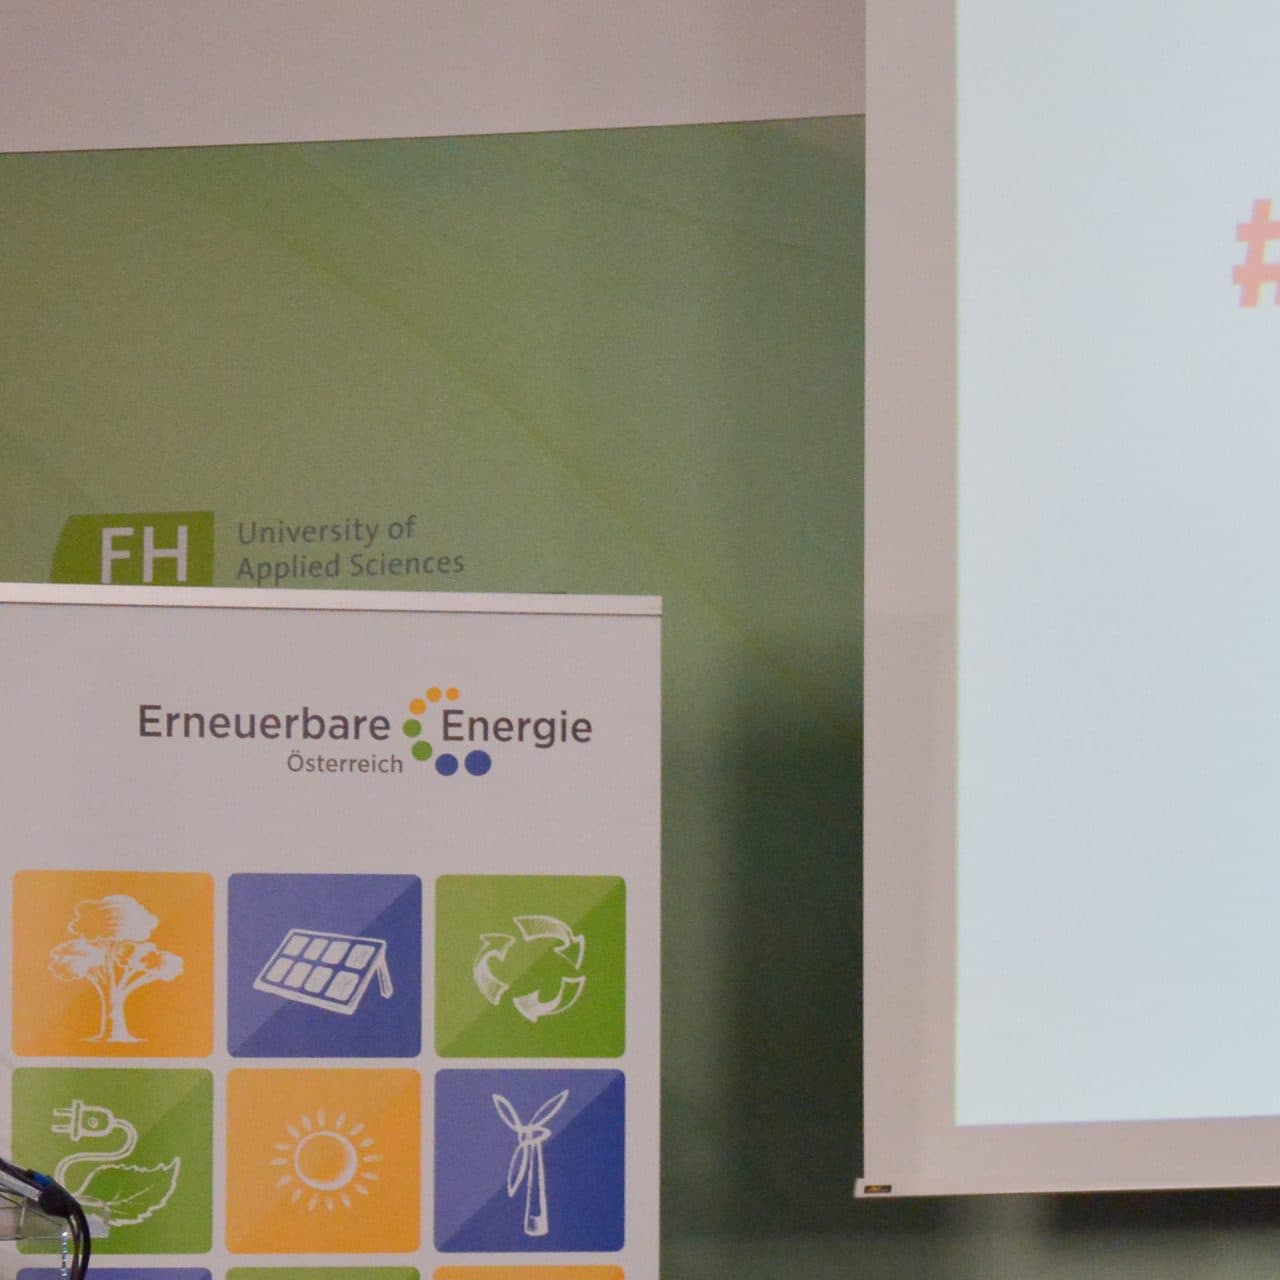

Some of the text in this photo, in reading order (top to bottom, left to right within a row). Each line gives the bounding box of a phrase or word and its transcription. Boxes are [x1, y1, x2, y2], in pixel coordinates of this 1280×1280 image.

[237, 514, 417, 549] University of
[101, 524, 188, 585] FH
[237, 551, 465, 586] Applied Sciences
[138, 704, 593, 748] Erneuerbare Energie
[287, 751, 404, 774] Österreich
